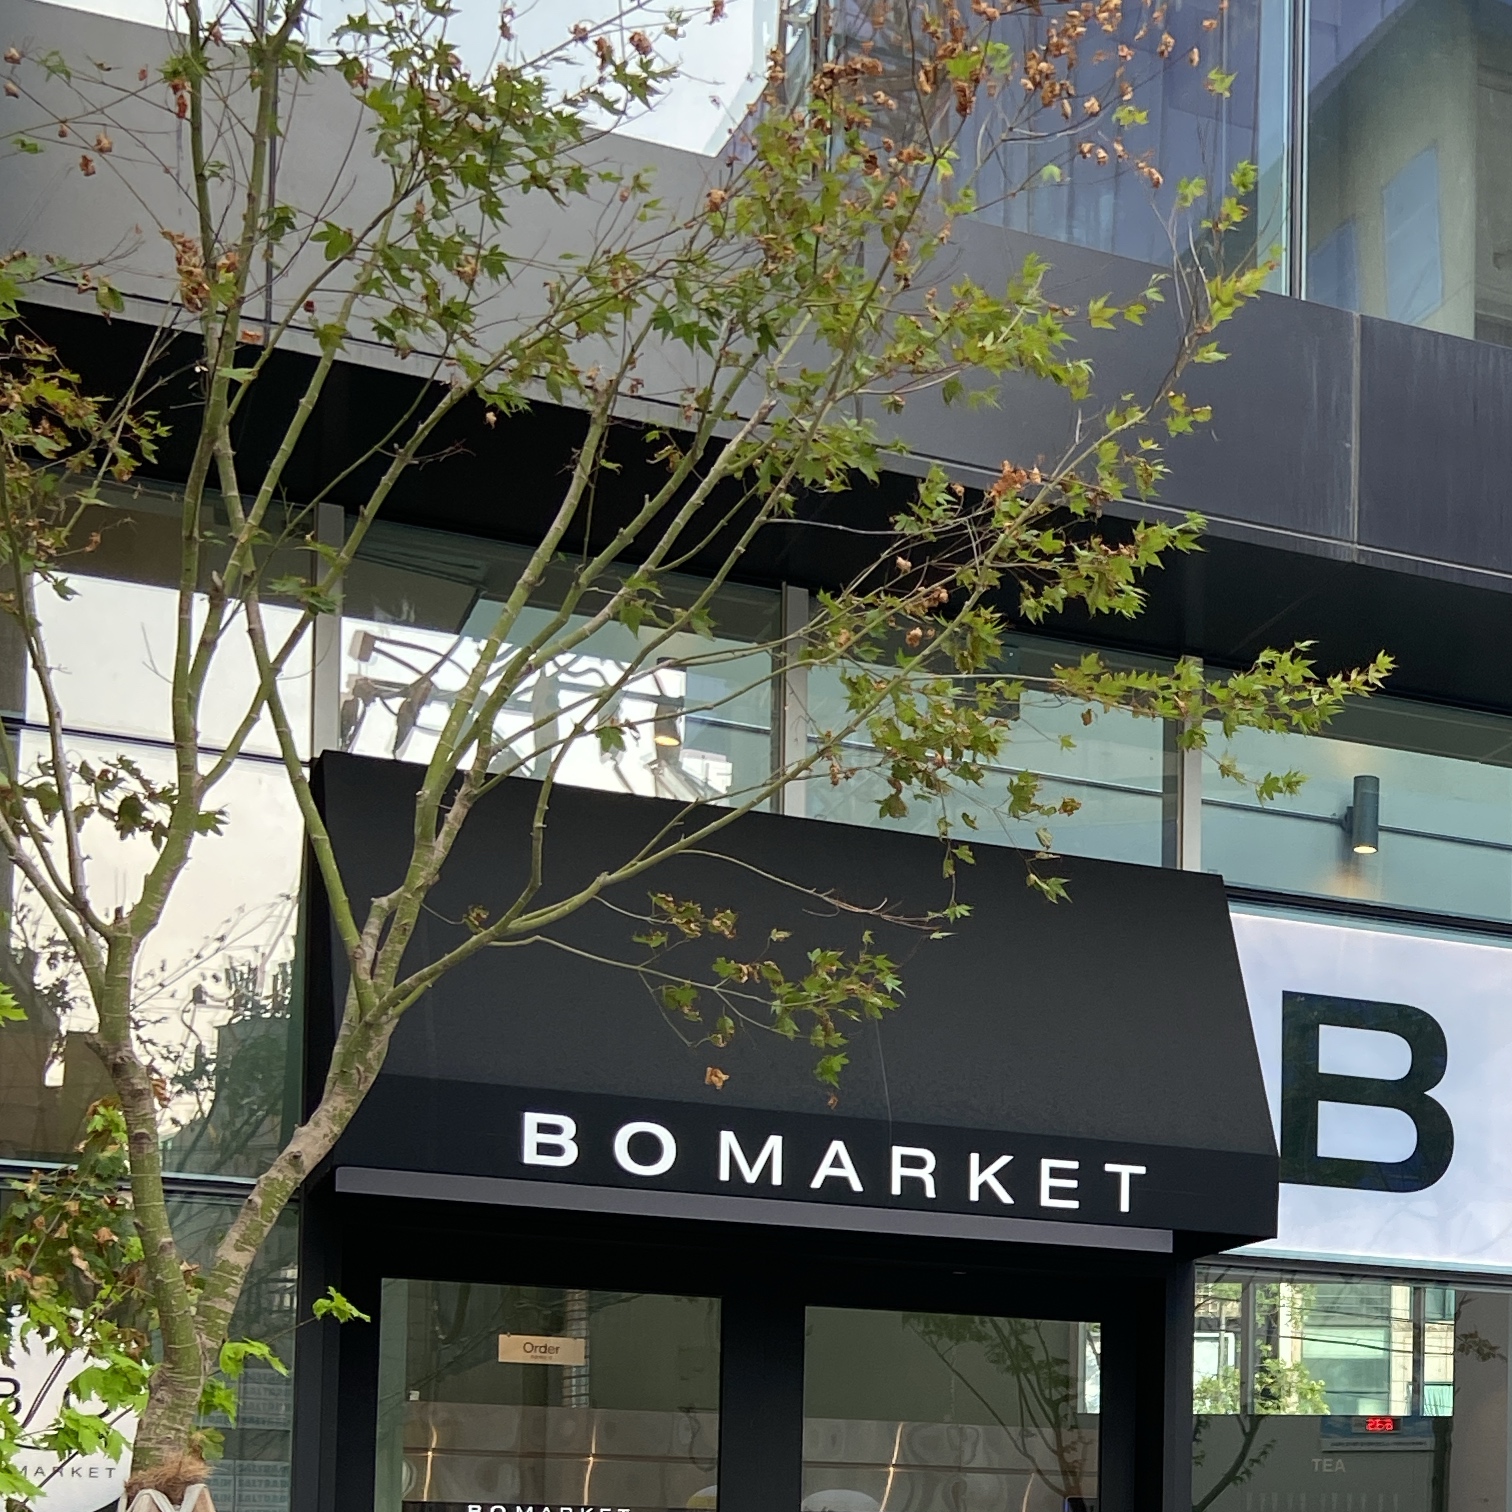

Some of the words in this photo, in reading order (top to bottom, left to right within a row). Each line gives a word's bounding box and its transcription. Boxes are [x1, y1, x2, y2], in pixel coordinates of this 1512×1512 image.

[522, 1110, 1147, 1213] BOMARKET
[522, 1342, 561, 1355] Order
[1311, 1458, 1346, 1473] TEA
